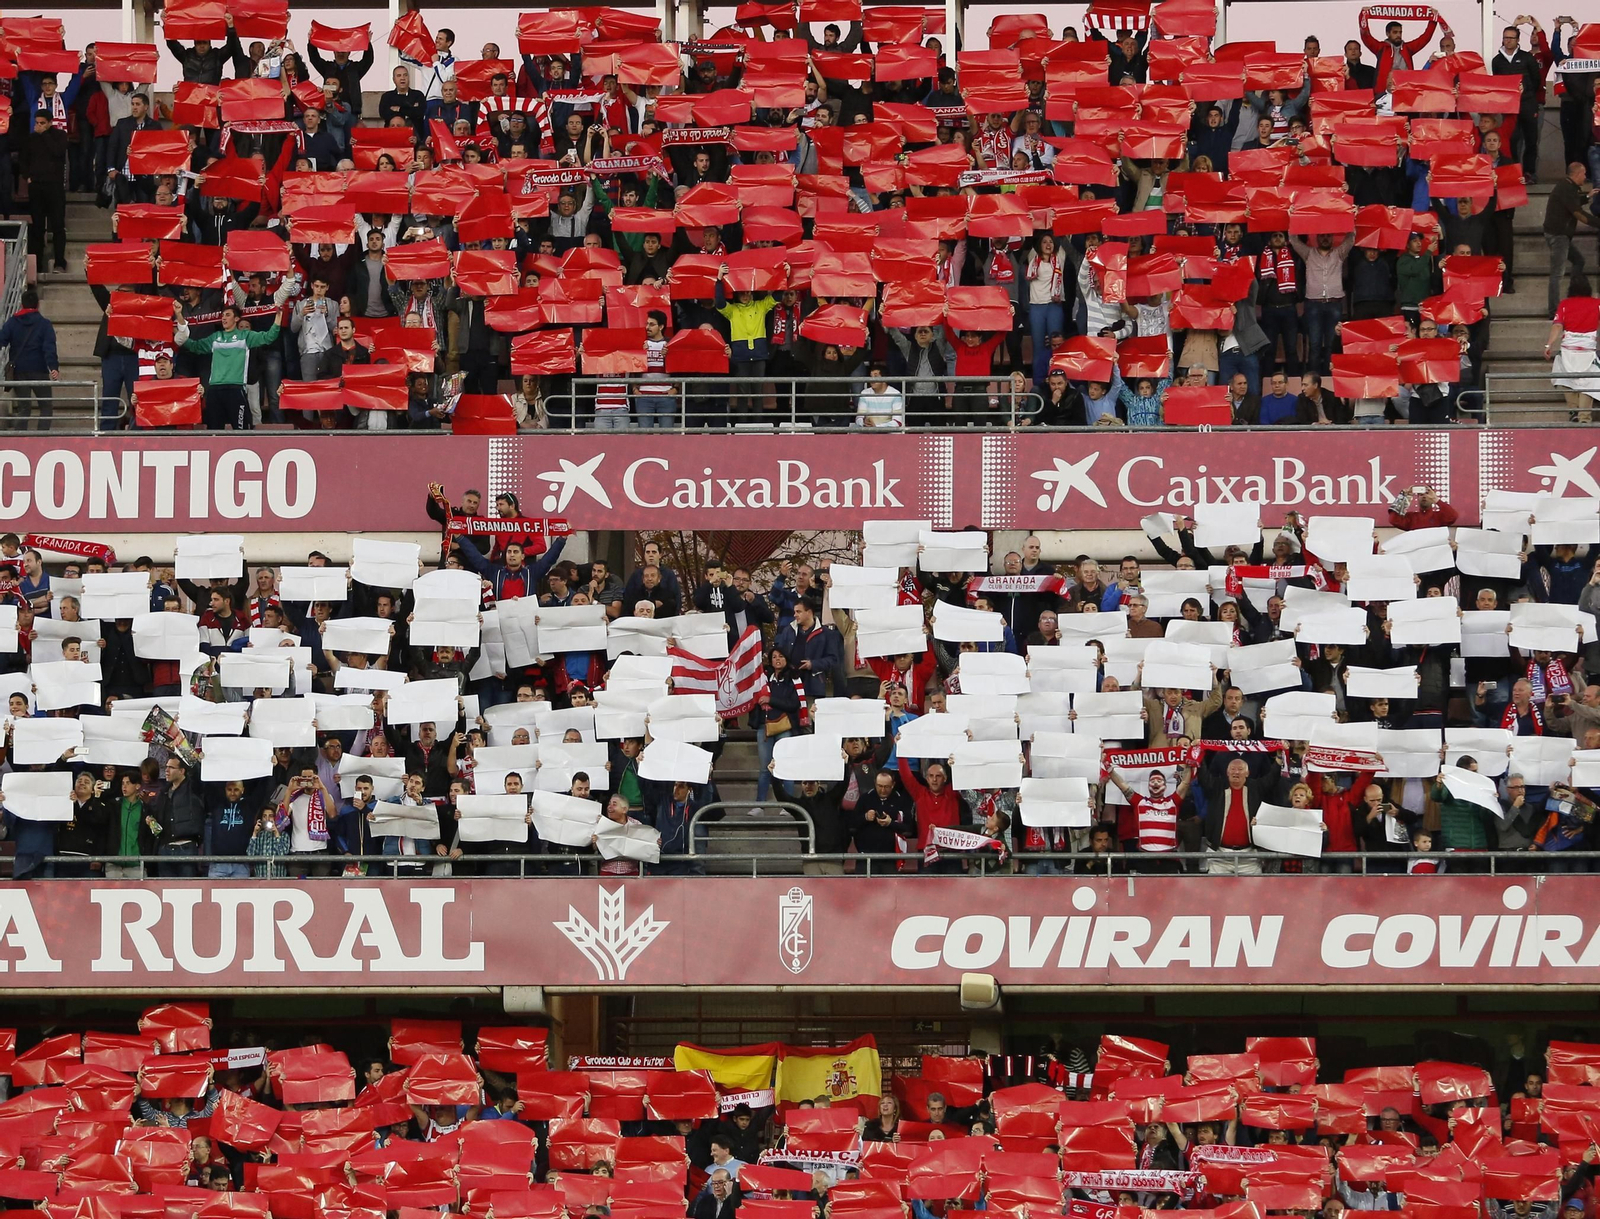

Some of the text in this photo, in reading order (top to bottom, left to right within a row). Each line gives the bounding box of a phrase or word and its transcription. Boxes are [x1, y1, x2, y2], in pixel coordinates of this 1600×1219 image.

[1370, 7, 1413, 17] GRANADA
[594, 158, 640, 169] GRANADA
[532, 173, 560, 183] Granada
[561, 171, 573, 182] Club
[0, 449, 317, 520] CONTIGO
[623, 457, 904, 508] CaixaBank
[1117, 455, 1398, 506] CaixaBank
[473, 520, 543, 533] GRANADA C.F.
[35, 536, 80, 551] GRANADA
[988, 576, 1036, 584] GRANADA
[1110, 751, 1165, 766] GRANADA
[937, 835, 978, 848] GRANADA
[91, 887, 484, 974] RURAL
[1321, 885, 1600, 968] COVIR
[584, 1056, 616, 1065] Granada
[617, 1056, 631, 1066] Club
[633, 1057, 641, 1066] de
